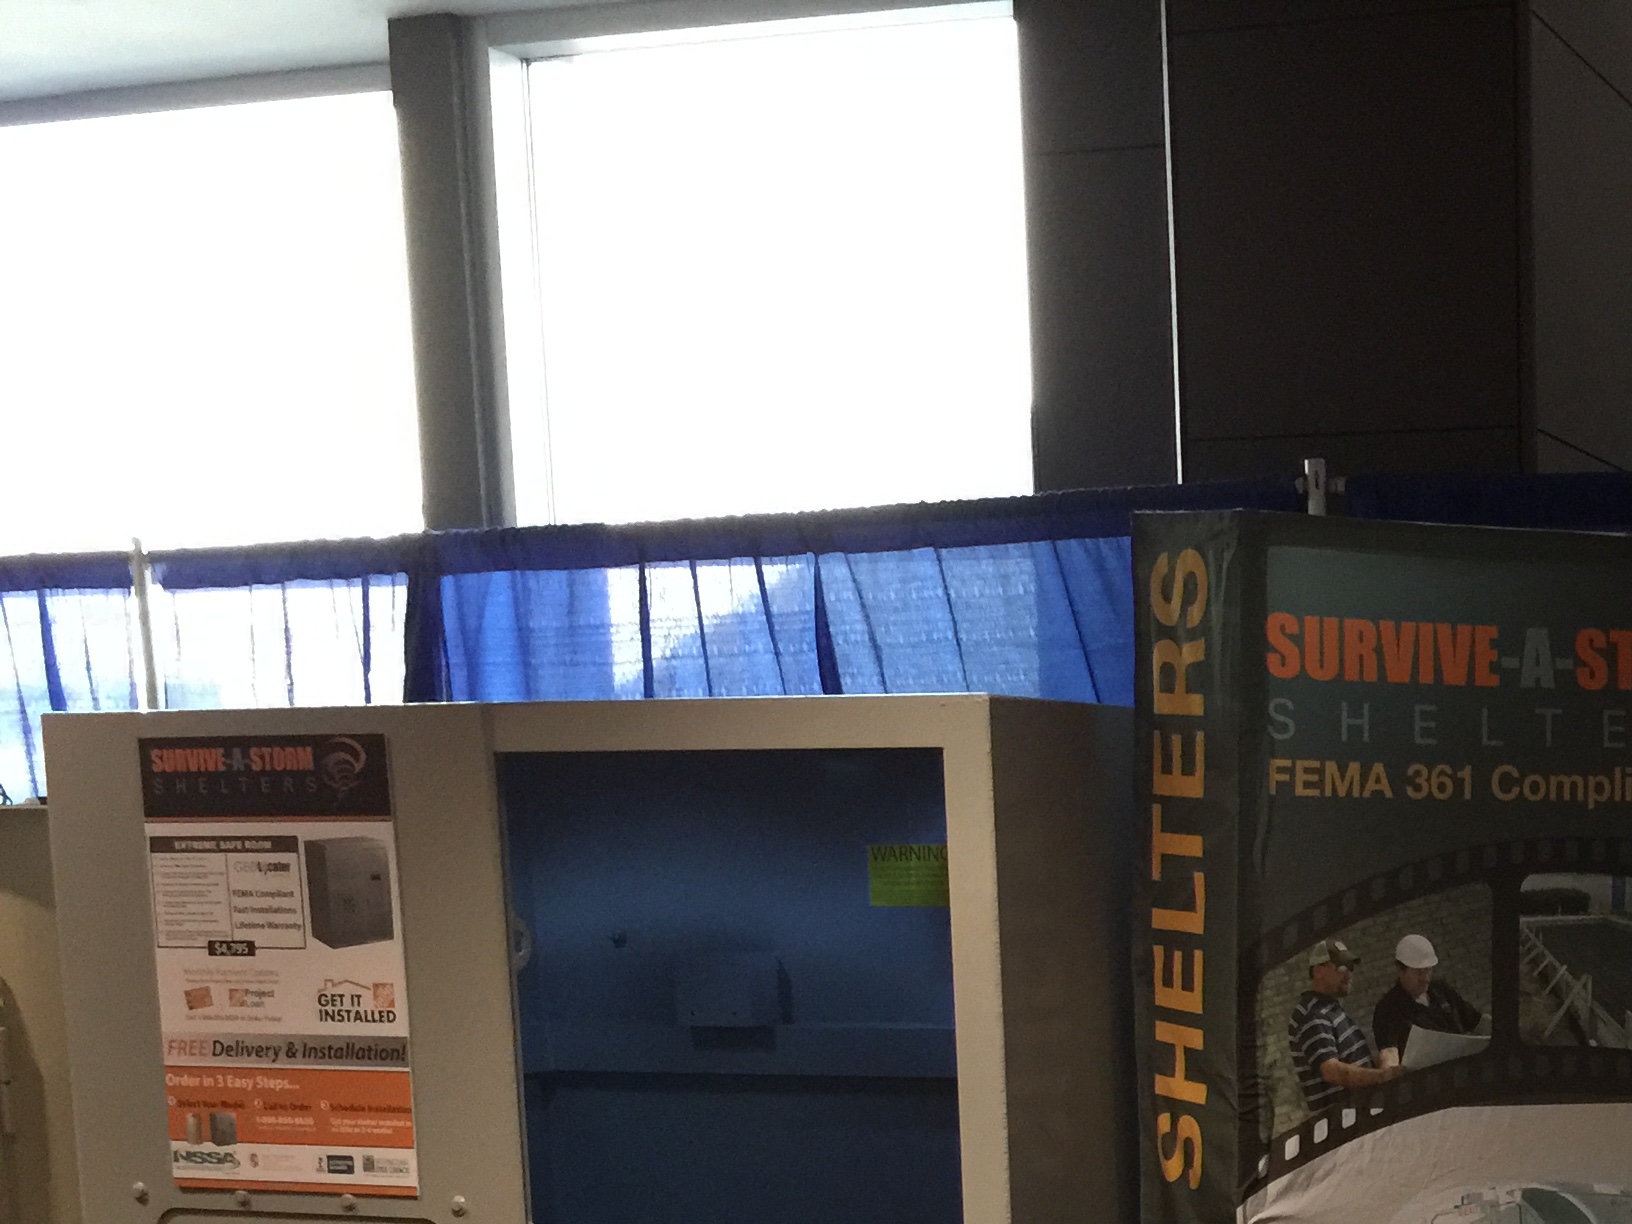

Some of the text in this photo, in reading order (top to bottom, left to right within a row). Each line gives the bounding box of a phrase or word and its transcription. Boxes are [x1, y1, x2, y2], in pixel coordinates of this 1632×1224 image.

[151, 746, 314, 772] SURVIVE-A-STORM
[152, 776, 318, 794] SHELTERS
[1267, 758, 1393, 799] FEMA
[1405, 762, 1475, 800] 361
[1151, 547, 1210, 1192] SHELTERS
[255, 890, 294, 899] Compliant
[235, 922, 265, 930] Lifetime
[245, 988, 275, 1000] Project
[317, 993, 363, 1008] GET IT
[318, 1009, 397, 1024] INSTALLED
[167, 1039, 407, 1063] FREE Delivery & Installation!
[165, 1074, 201, 1088] Order
[203, 1075, 215, 1087] in
[216, 1075, 225, 1088] 3
[226, 1076, 254, 1091] Easy
[173, 1150, 239, 1167] NSSA
